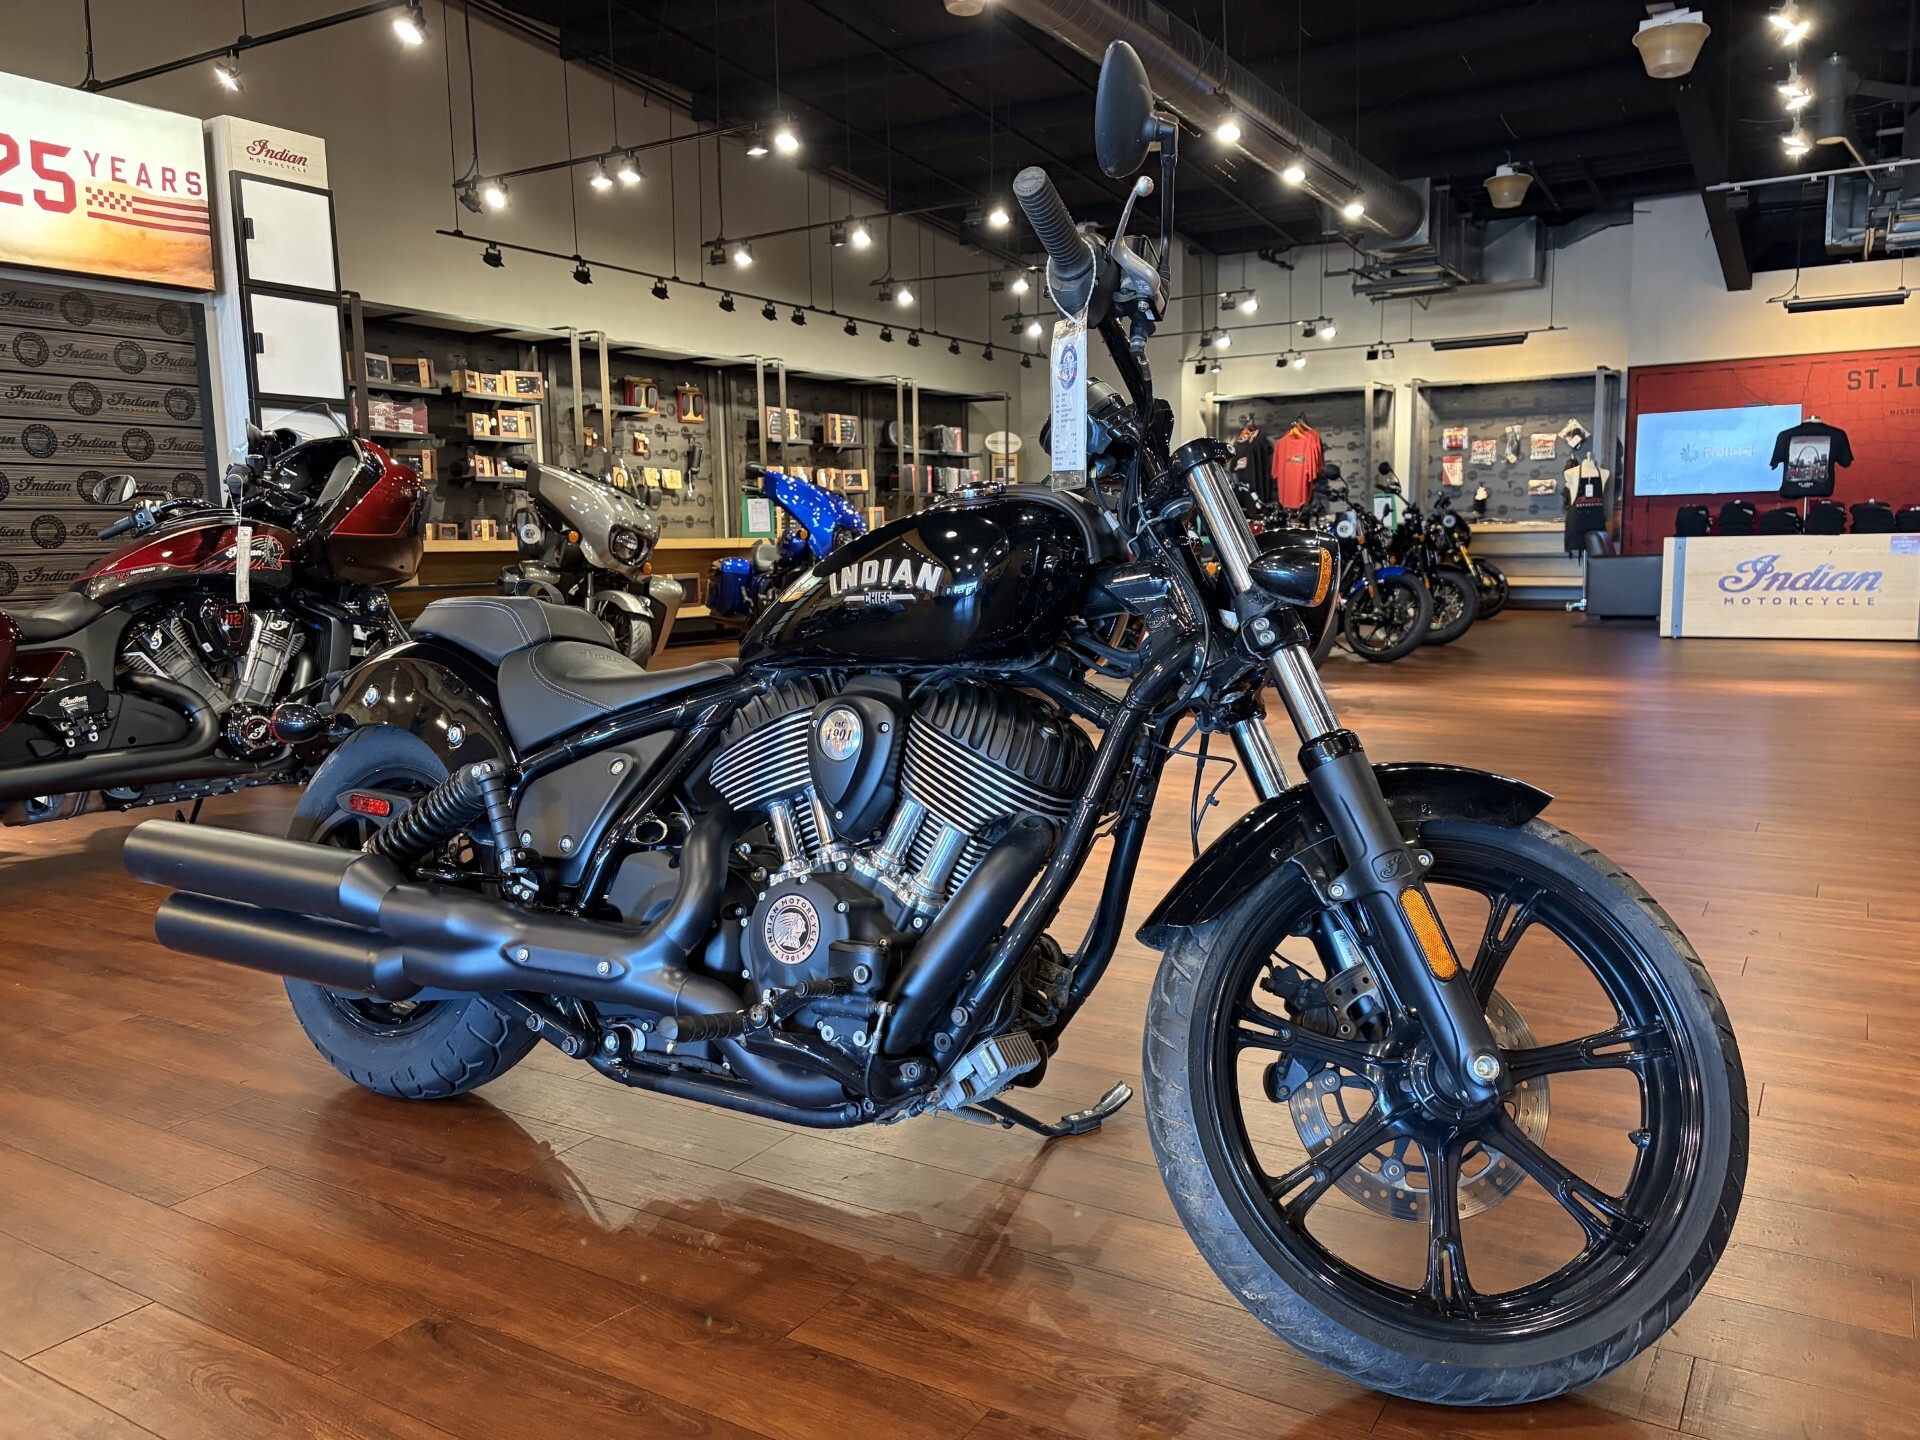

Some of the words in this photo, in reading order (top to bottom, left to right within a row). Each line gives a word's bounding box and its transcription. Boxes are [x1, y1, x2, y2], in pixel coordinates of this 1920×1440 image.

[246, 139, 308, 166] Indian
[83, 149, 202, 196] YEARS
[249, 156, 307, 173] MOTORCYCLE
[53, 343, 109, 361] Indian
[1847, 368, 1887, 390] ST.
[4, 384, 63, 402] Indian
[106, 391, 160, 408] Indian
[61, 432, 117, 449] Indian
[14, 475, 72, 492] Indian
[828, 558, 944, 597] INDIAN
[1718, 554, 1883, 593] Indian
[864, 591, 893, 605] CHIEF
[1723, 597, 1875, 606] MOTORCYCLE
[225, 613, 242, 625] 112
[826, 728, 853, 741] 1901
[767, 906, 780, 949] INDIAN
[781, 897, 817, 951] MOTORCYCLE
[780, 953, 801, 962] 1901
